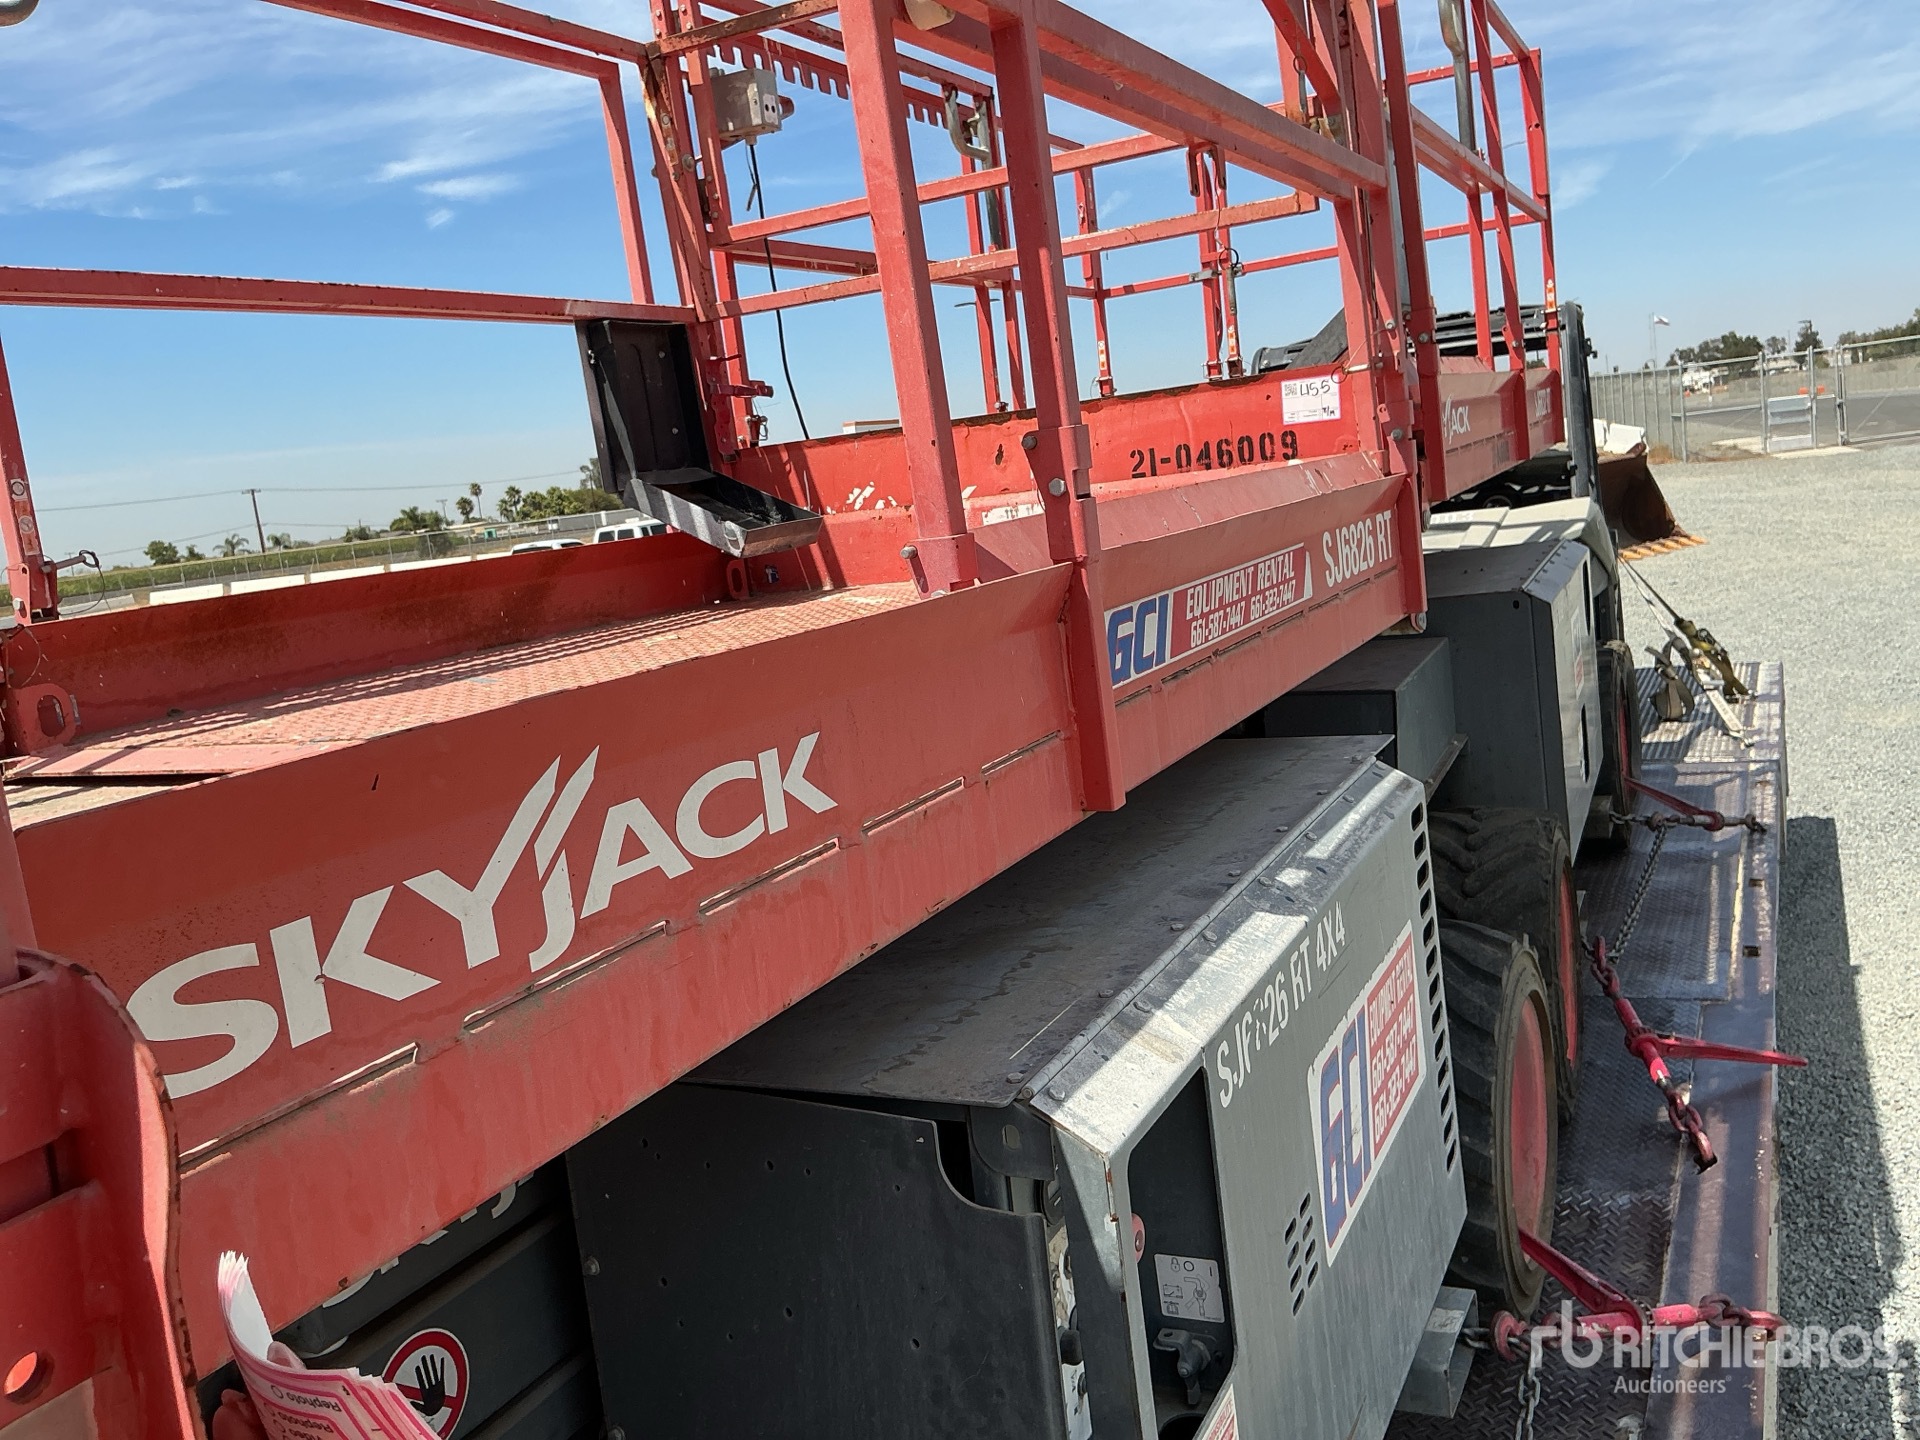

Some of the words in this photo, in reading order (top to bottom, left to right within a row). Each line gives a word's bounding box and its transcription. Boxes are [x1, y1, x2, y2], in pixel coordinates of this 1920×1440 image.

[1129, 430, 1299, 479] 21-046009
[1186, 564, 1255, 621] EQUIPMENT
[1257, 551, 1296, 594] RENTAL
[1322, 519, 1375, 589] SJ6826
[1375, 509, 1394, 564] RT
[1107, 593, 1171, 687] GCI
[1190, 604, 1246, 648] 661-587-7447
[1250, 579, 1297, 621] 661-323-7447
[125, 731, 839, 1099] SKYJACK
[1290, 935, 1312, 1011] RT
[1315, 900, 1346, 972] 4X4
[1321, 1003, 1373, 1249] GCI
[285, 1390, 343, 1413] Rephoto
